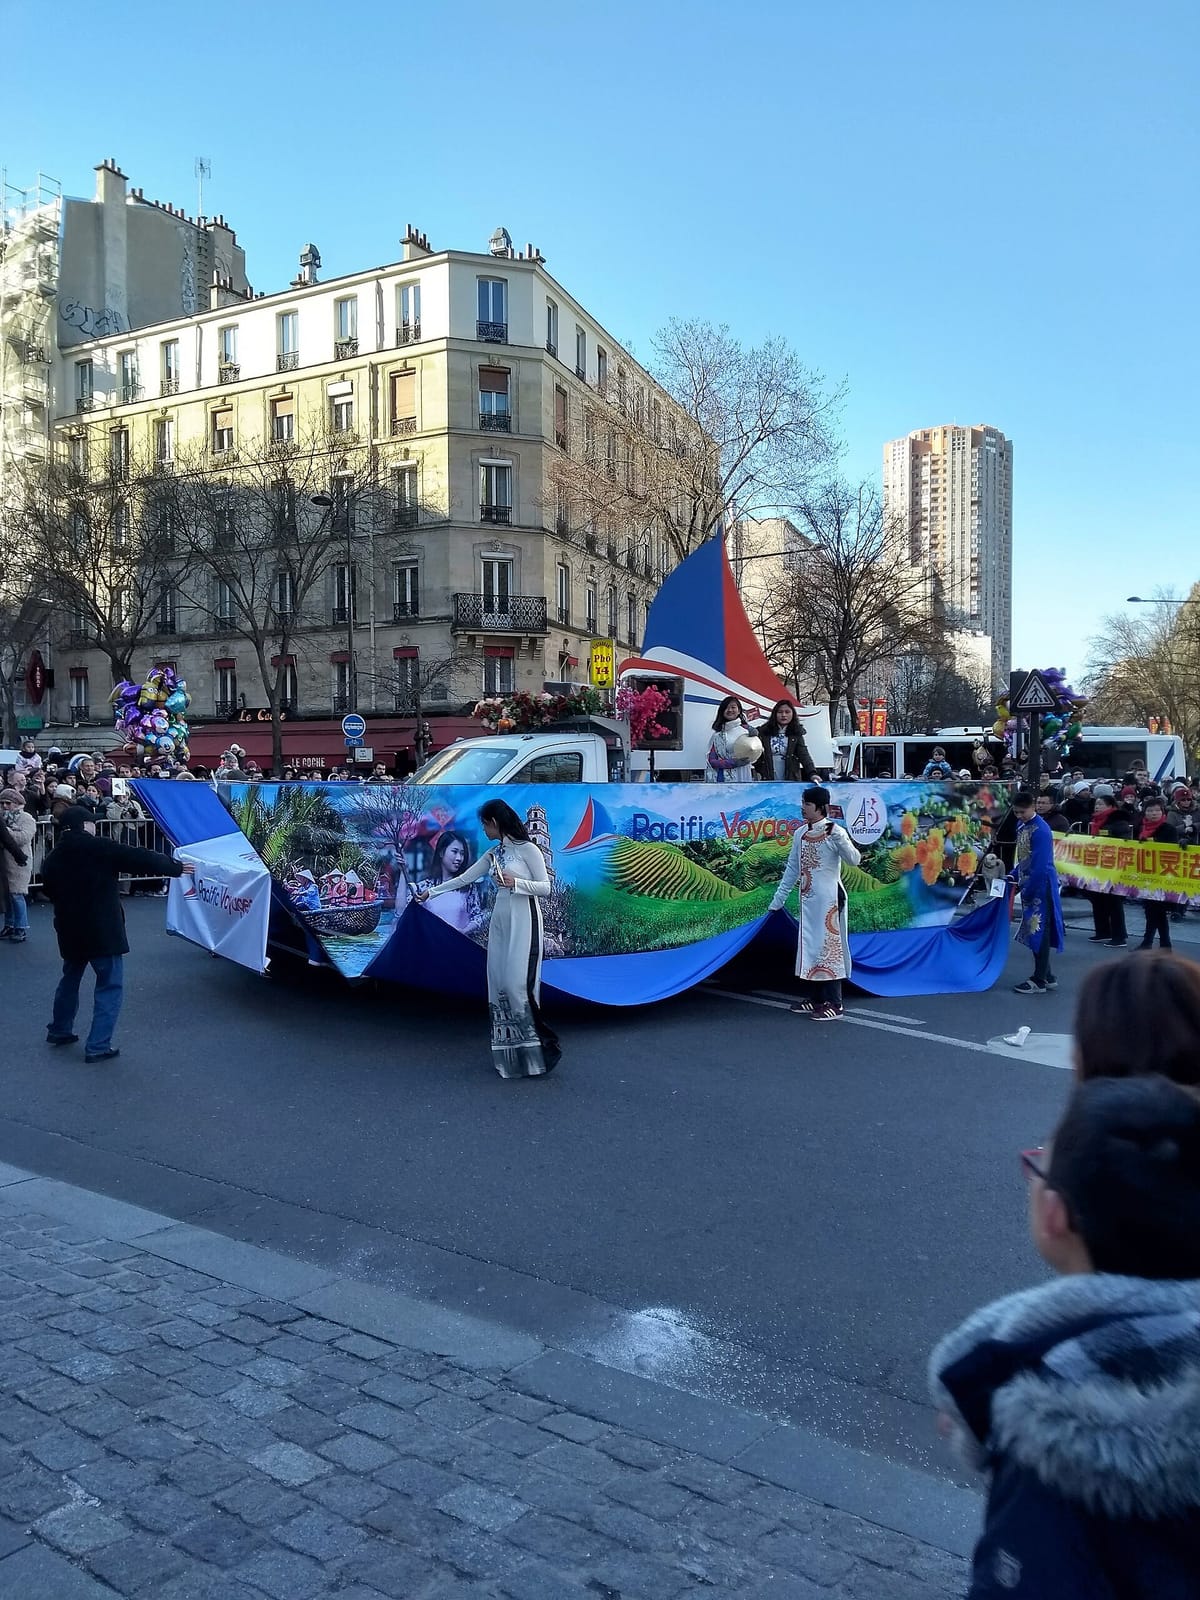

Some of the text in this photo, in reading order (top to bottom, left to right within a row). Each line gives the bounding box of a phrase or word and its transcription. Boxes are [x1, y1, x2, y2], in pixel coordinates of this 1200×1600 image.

[595, 666, 609, 675] 14
[239, 708, 286, 721] Le Coe
[291, 757, 300, 767] LE
[633, 811, 808, 846] Pacific Voyage
[199, 879, 220, 906] Pacific
